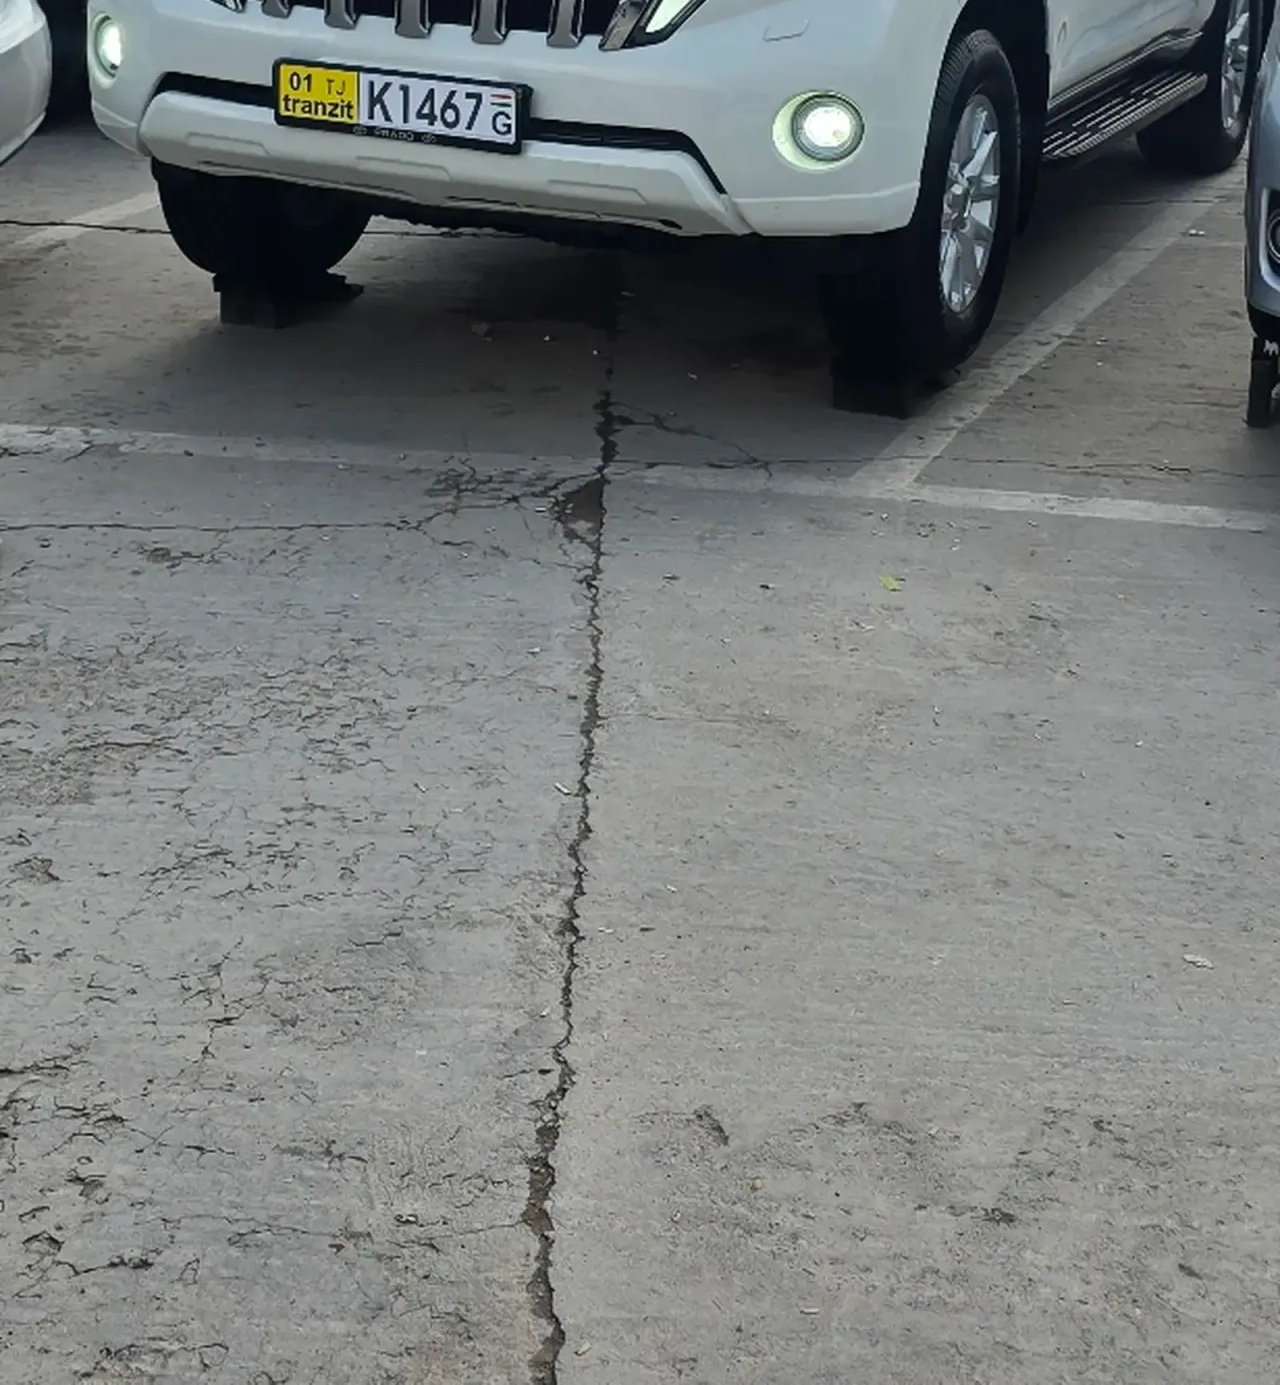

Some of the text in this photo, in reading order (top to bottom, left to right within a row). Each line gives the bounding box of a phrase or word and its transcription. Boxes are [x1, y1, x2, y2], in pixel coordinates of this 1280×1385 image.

[288, 71, 346, 96] 01 TJ
[282, 94, 354, 120] tranzit
[367, 79, 483, 131] K1467
[491, 111, 512, 136] G
